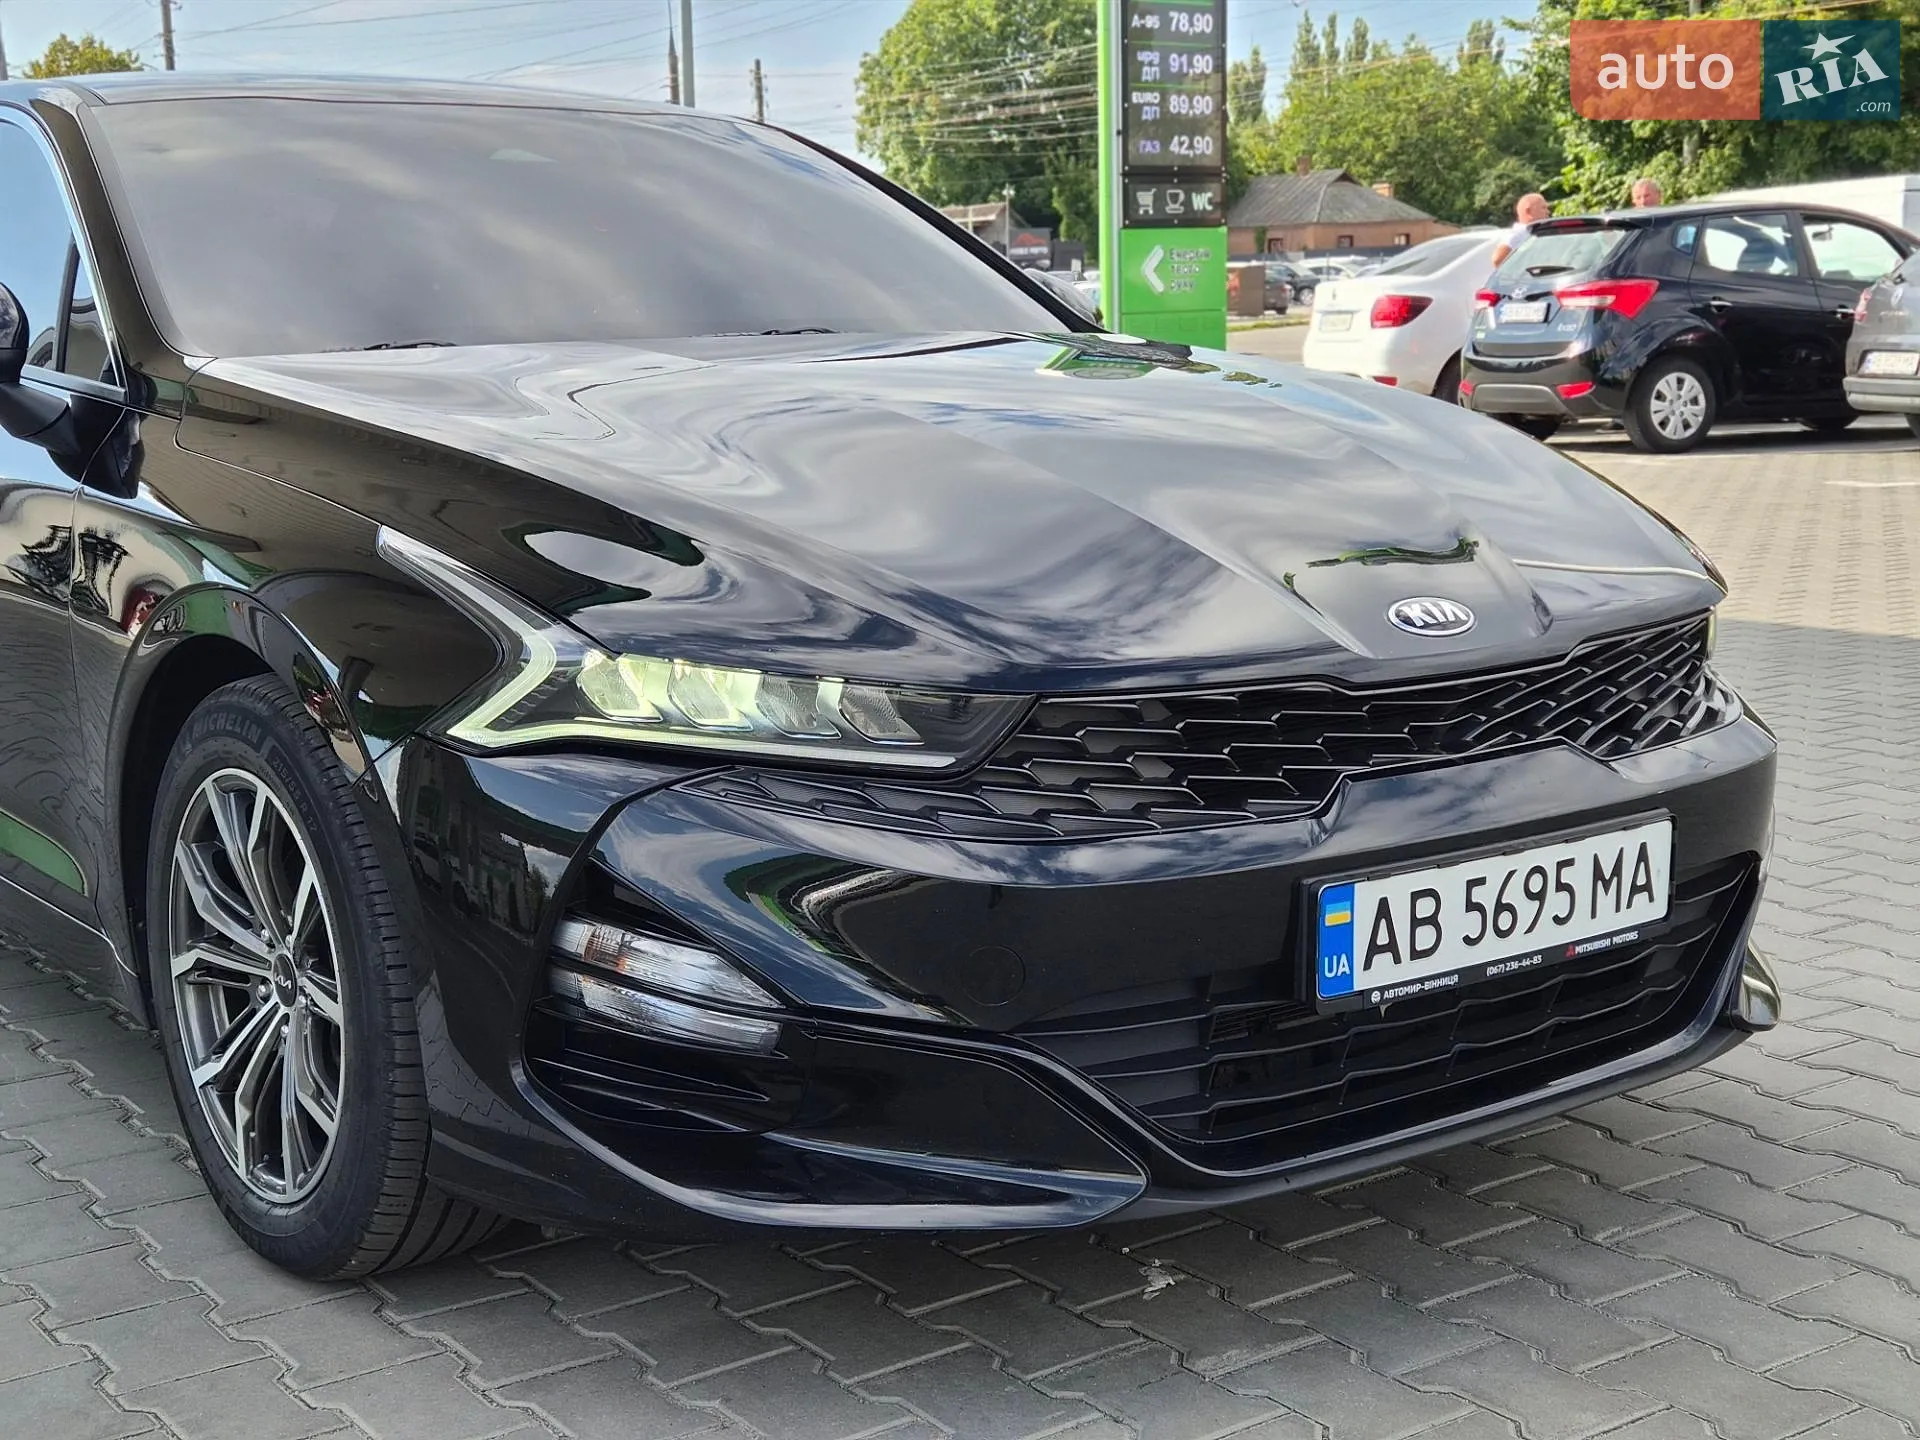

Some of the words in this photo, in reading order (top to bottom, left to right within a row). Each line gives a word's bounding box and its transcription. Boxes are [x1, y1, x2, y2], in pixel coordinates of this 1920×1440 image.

[1169, 11, 1213, 36] 78,90
[1141, 66, 1160, 82] ДП
[1169, 53, 1213, 77] 91,90
[1131, 92, 1160, 104] EURO
[1169, 94, 1213, 117] 89,90
[1141, 105, 1160, 121] ДП
[1139, 139, 1160, 154] ГАЗ
[1169, 135, 1213, 158] 42,90
[1191, 191, 1213, 211] WC
[1399, 600, 1468, 627] KIA
[192, 711, 262, 745] MICHELIN
[1362, 887, 1443, 972] AB
[1462, 857, 1577, 947] 5695
[1590, 841, 1655, 920] MA
[1575, 938, 1611, 955] MITSUBISHI
[1612, 931, 1639, 946] MOTORS
[1323, 954, 1351, 979] UA
[1486, 964, 1505, 977] (067)
[1383, 974, 1459, 1000] АВТОМИР-ВІННИЦЯ
